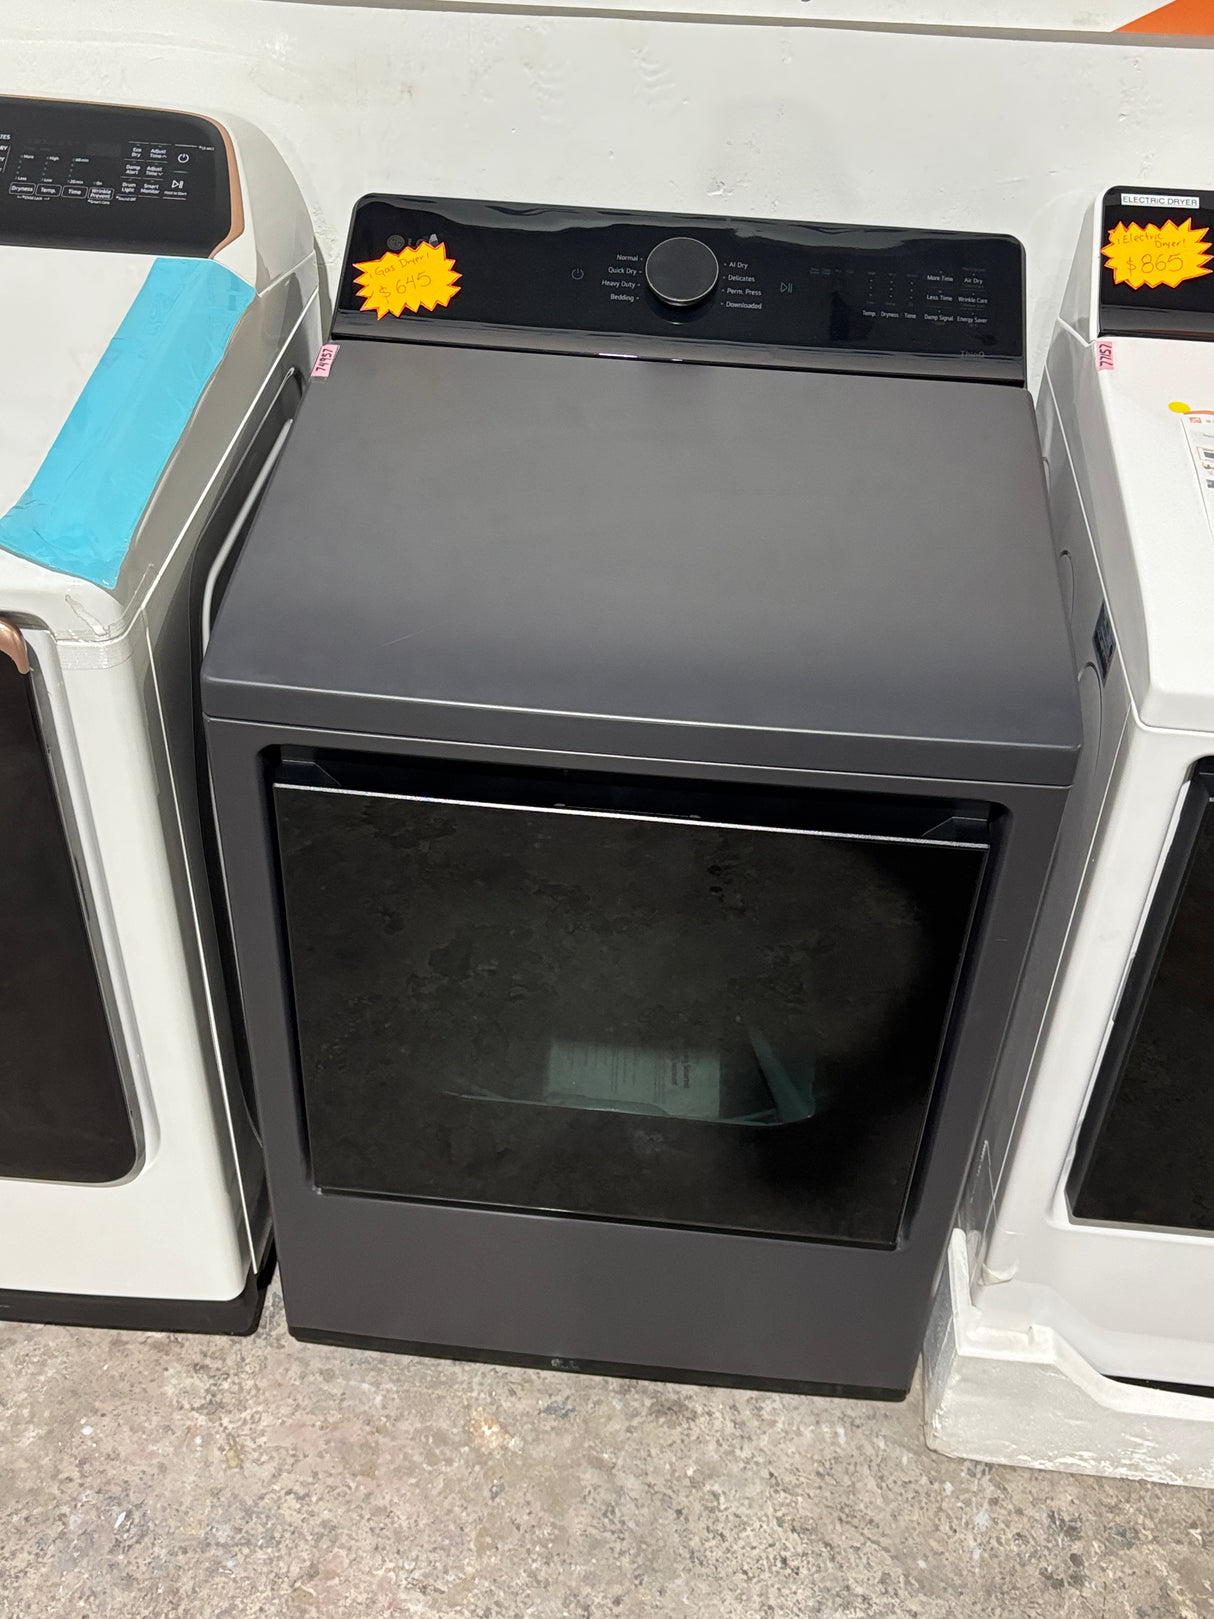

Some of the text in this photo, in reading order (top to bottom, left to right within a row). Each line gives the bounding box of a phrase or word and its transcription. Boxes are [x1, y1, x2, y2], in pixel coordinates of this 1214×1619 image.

[1123, 195, 1198, 206] ELECTRIC DRYER
[737, 262, 748, 270] Dry
[608, 266, 637, 276] Quick Dry
[728, 274, 755, 282] Delicates
[602, 279, 636, 289] Heavy Duty
[610, 293, 635, 303] Bedding
[726, 301, 762, 310] Downloaded
[924, 314, 953, 322] Damp Signal
[957, 316, 973, 324] Energy
